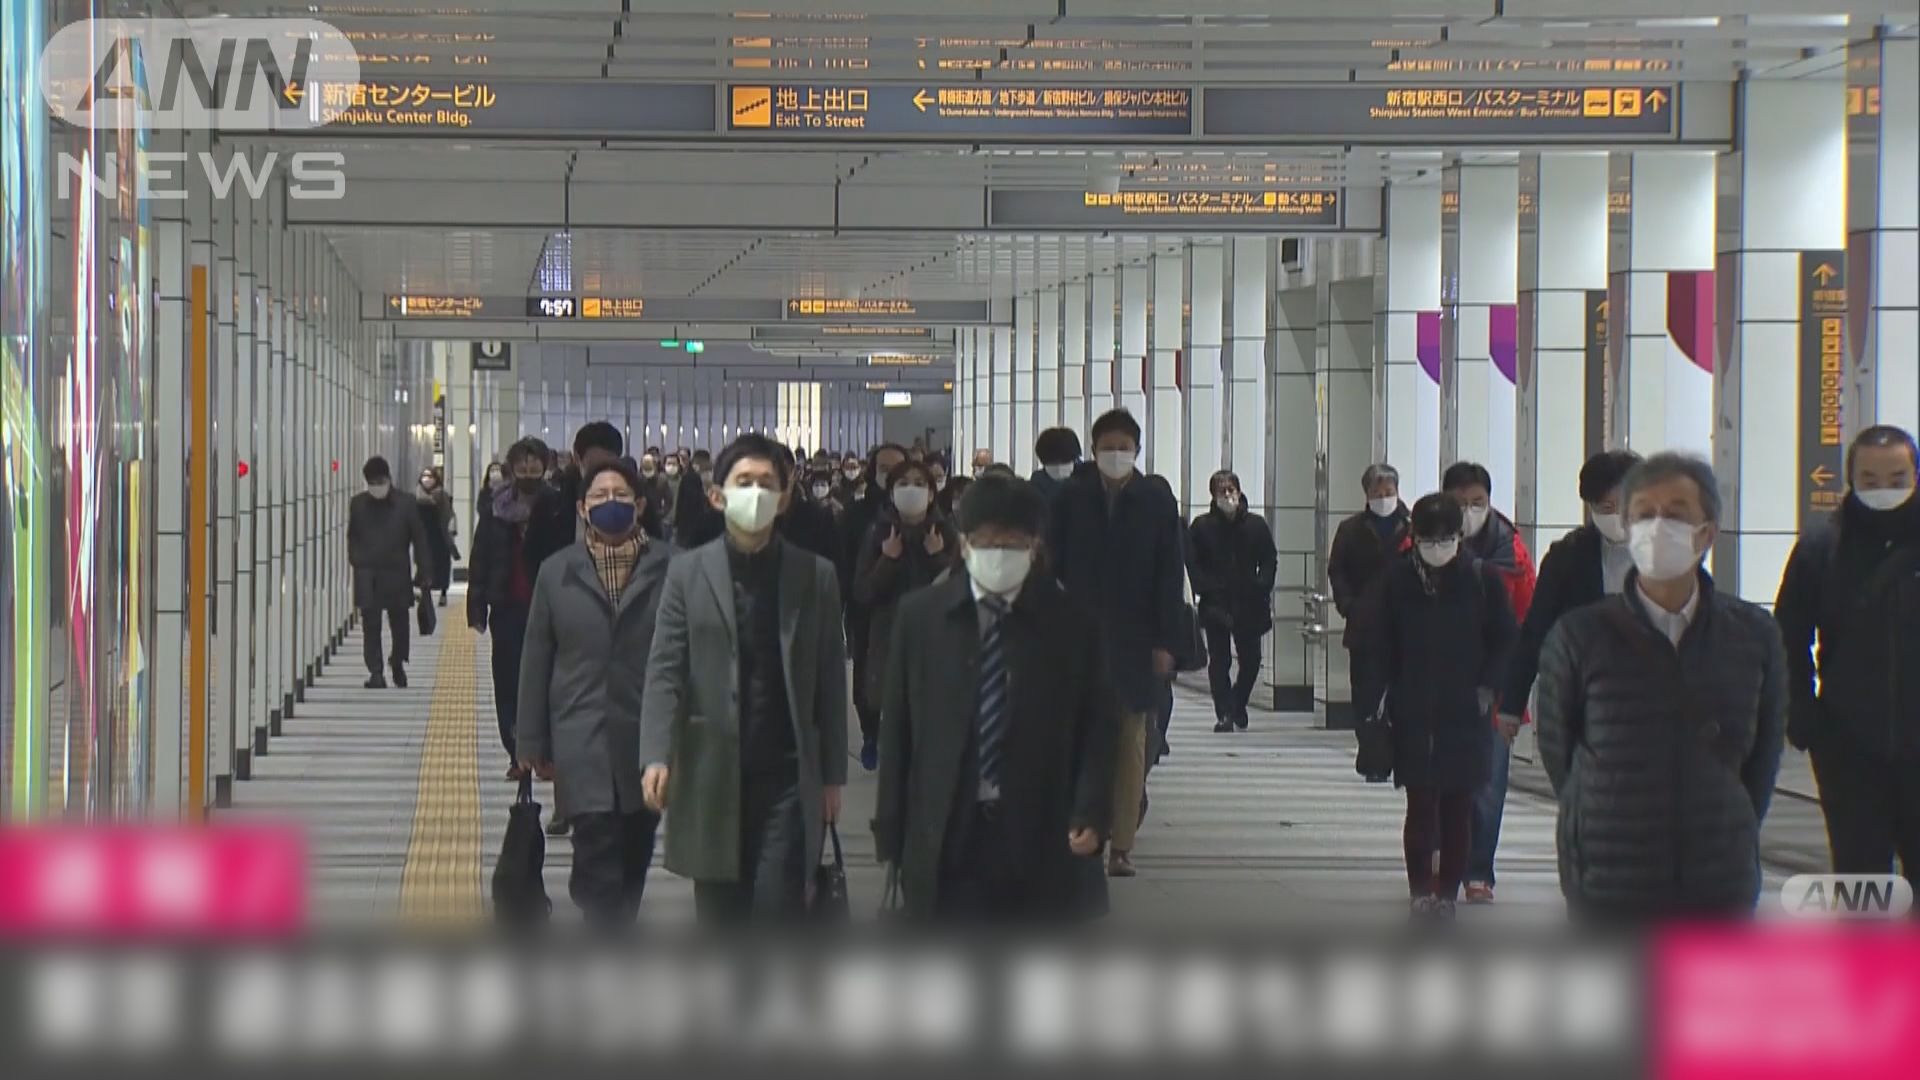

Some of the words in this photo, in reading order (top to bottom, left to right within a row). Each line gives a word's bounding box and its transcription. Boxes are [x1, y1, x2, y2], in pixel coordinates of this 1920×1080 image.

[322, 83, 495, 107] 新宿センタービル
[776, 87, 868, 112] 地上出口
[323, 110, 383, 125] Shinjuku
[386, 110, 432, 123] Center
[437, 110, 472, 126] Bldg.
[776, 114, 800, 127] Exit
[804, 114, 821, 127] To
[825, 114, 865, 127] Street
[1370, 108, 1409, 119] Shinjuku
[1412, 108, 1445, 117] Station
[1447, 108, 1470, 117] West
[1473, 108, 1513, 117] Entrance
[1540, 107, 1579, 117] Terminal
[540, 298, 572, 316] 7:57
